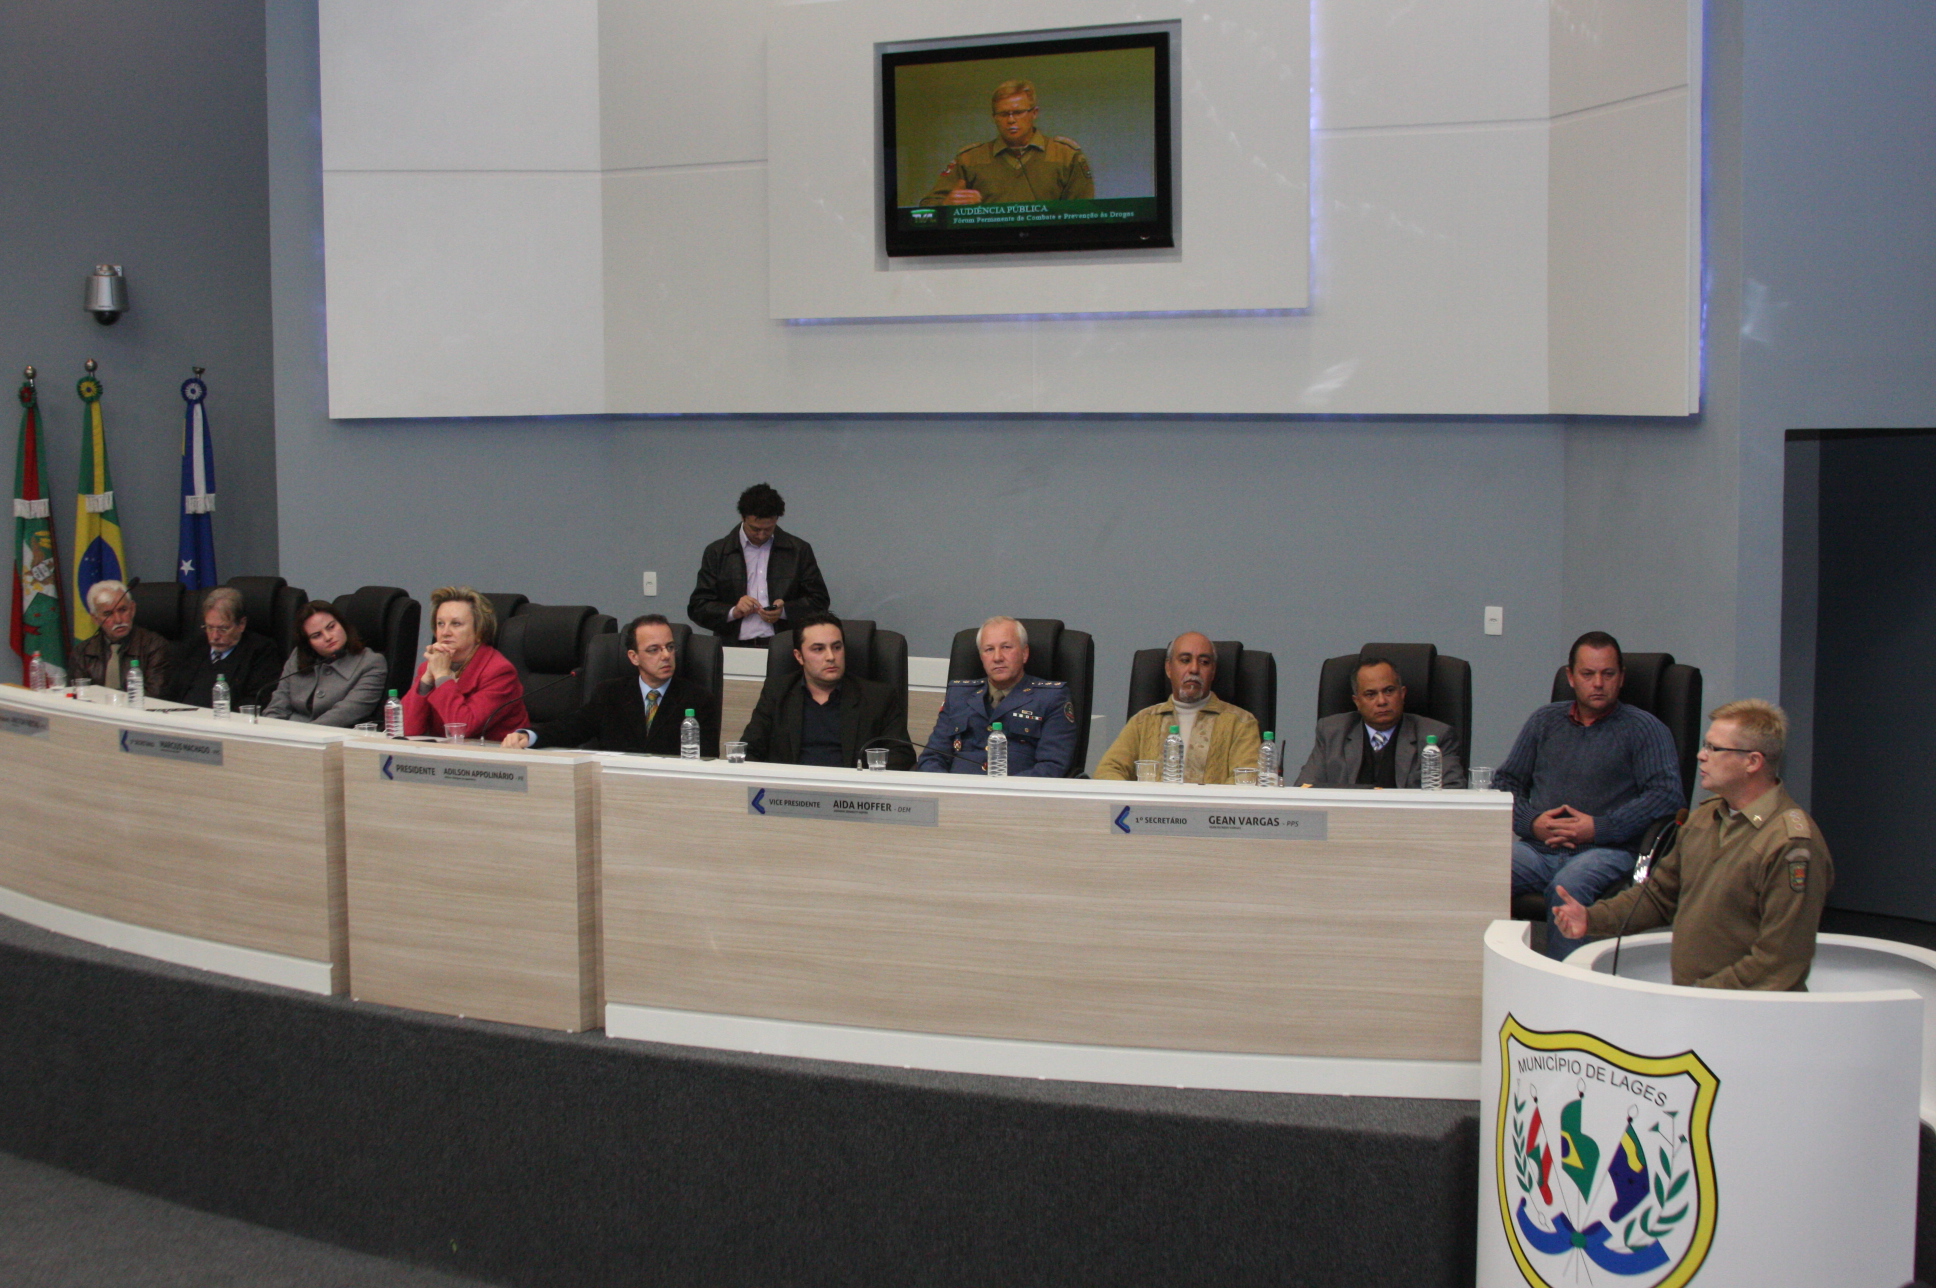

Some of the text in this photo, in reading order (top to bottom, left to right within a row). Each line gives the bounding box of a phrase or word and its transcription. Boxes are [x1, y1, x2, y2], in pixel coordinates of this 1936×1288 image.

[1006, 203, 1048, 214] PÚBLICA
[1016, 214, 1025, 222] de
[1026, 213, 1056, 221] Combate
[1110, 210, 1135, 219] Drogas
[396, 764, 436, 776] PRESIDENTE
[443, 767, 471, 777] ADILSON
[471, 769, 514, 781] APPOLINÁRIO
[769, 798, 783, 806] VICE
[784, 799, 821, 808] PRESIDENTE
[833, 799, 855, 810] AIDA
[857, 801, 892, 812] HOFFER
[1145, 816, 1188, 825] SECRETÁRIO
[1208, 815, 1236, 825] GEAN
[1238, 816, 1280, 827] VARGAS
[1517, 1053, 1667, 1107] MUNICÍPIO DE LAGES
